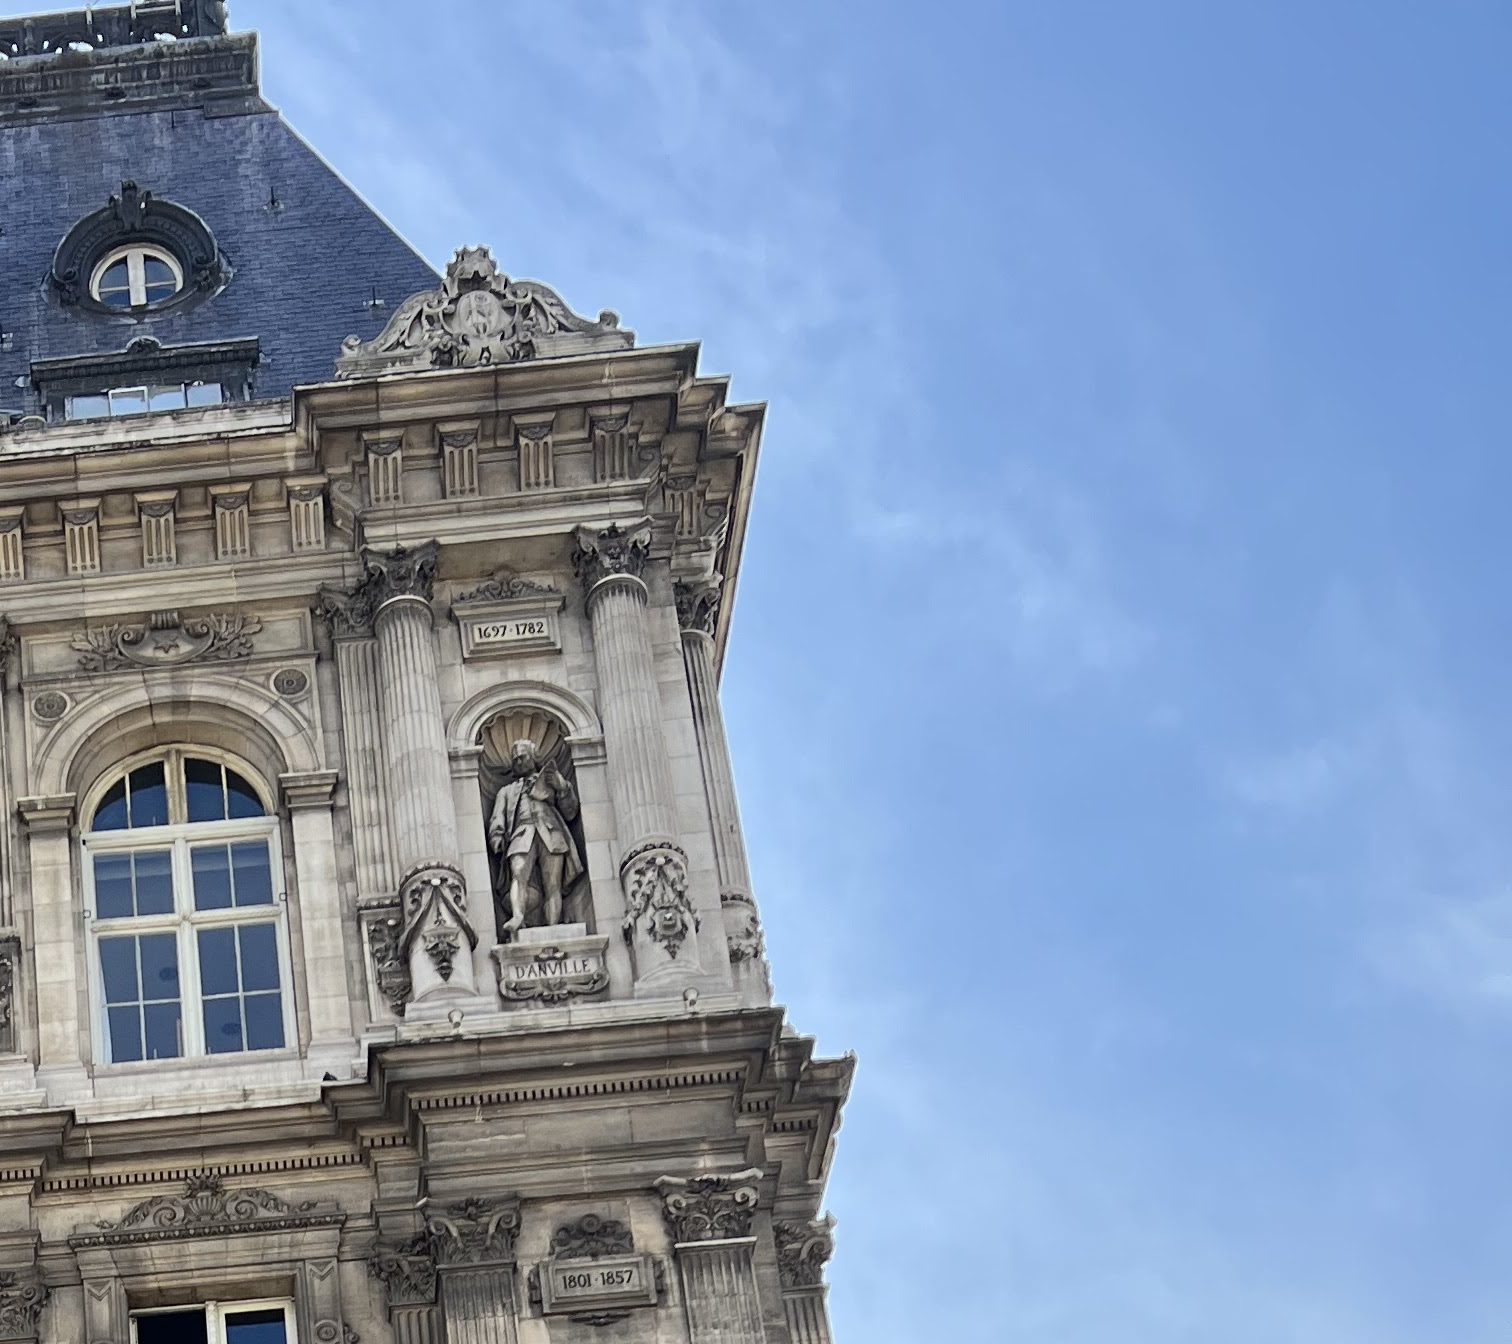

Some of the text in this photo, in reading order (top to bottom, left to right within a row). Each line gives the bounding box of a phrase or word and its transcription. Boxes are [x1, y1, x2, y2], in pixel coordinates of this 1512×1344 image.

[478, 621, 544, 639] 1697 1782
[562, 1270, 633, 1289] 1801 1857
